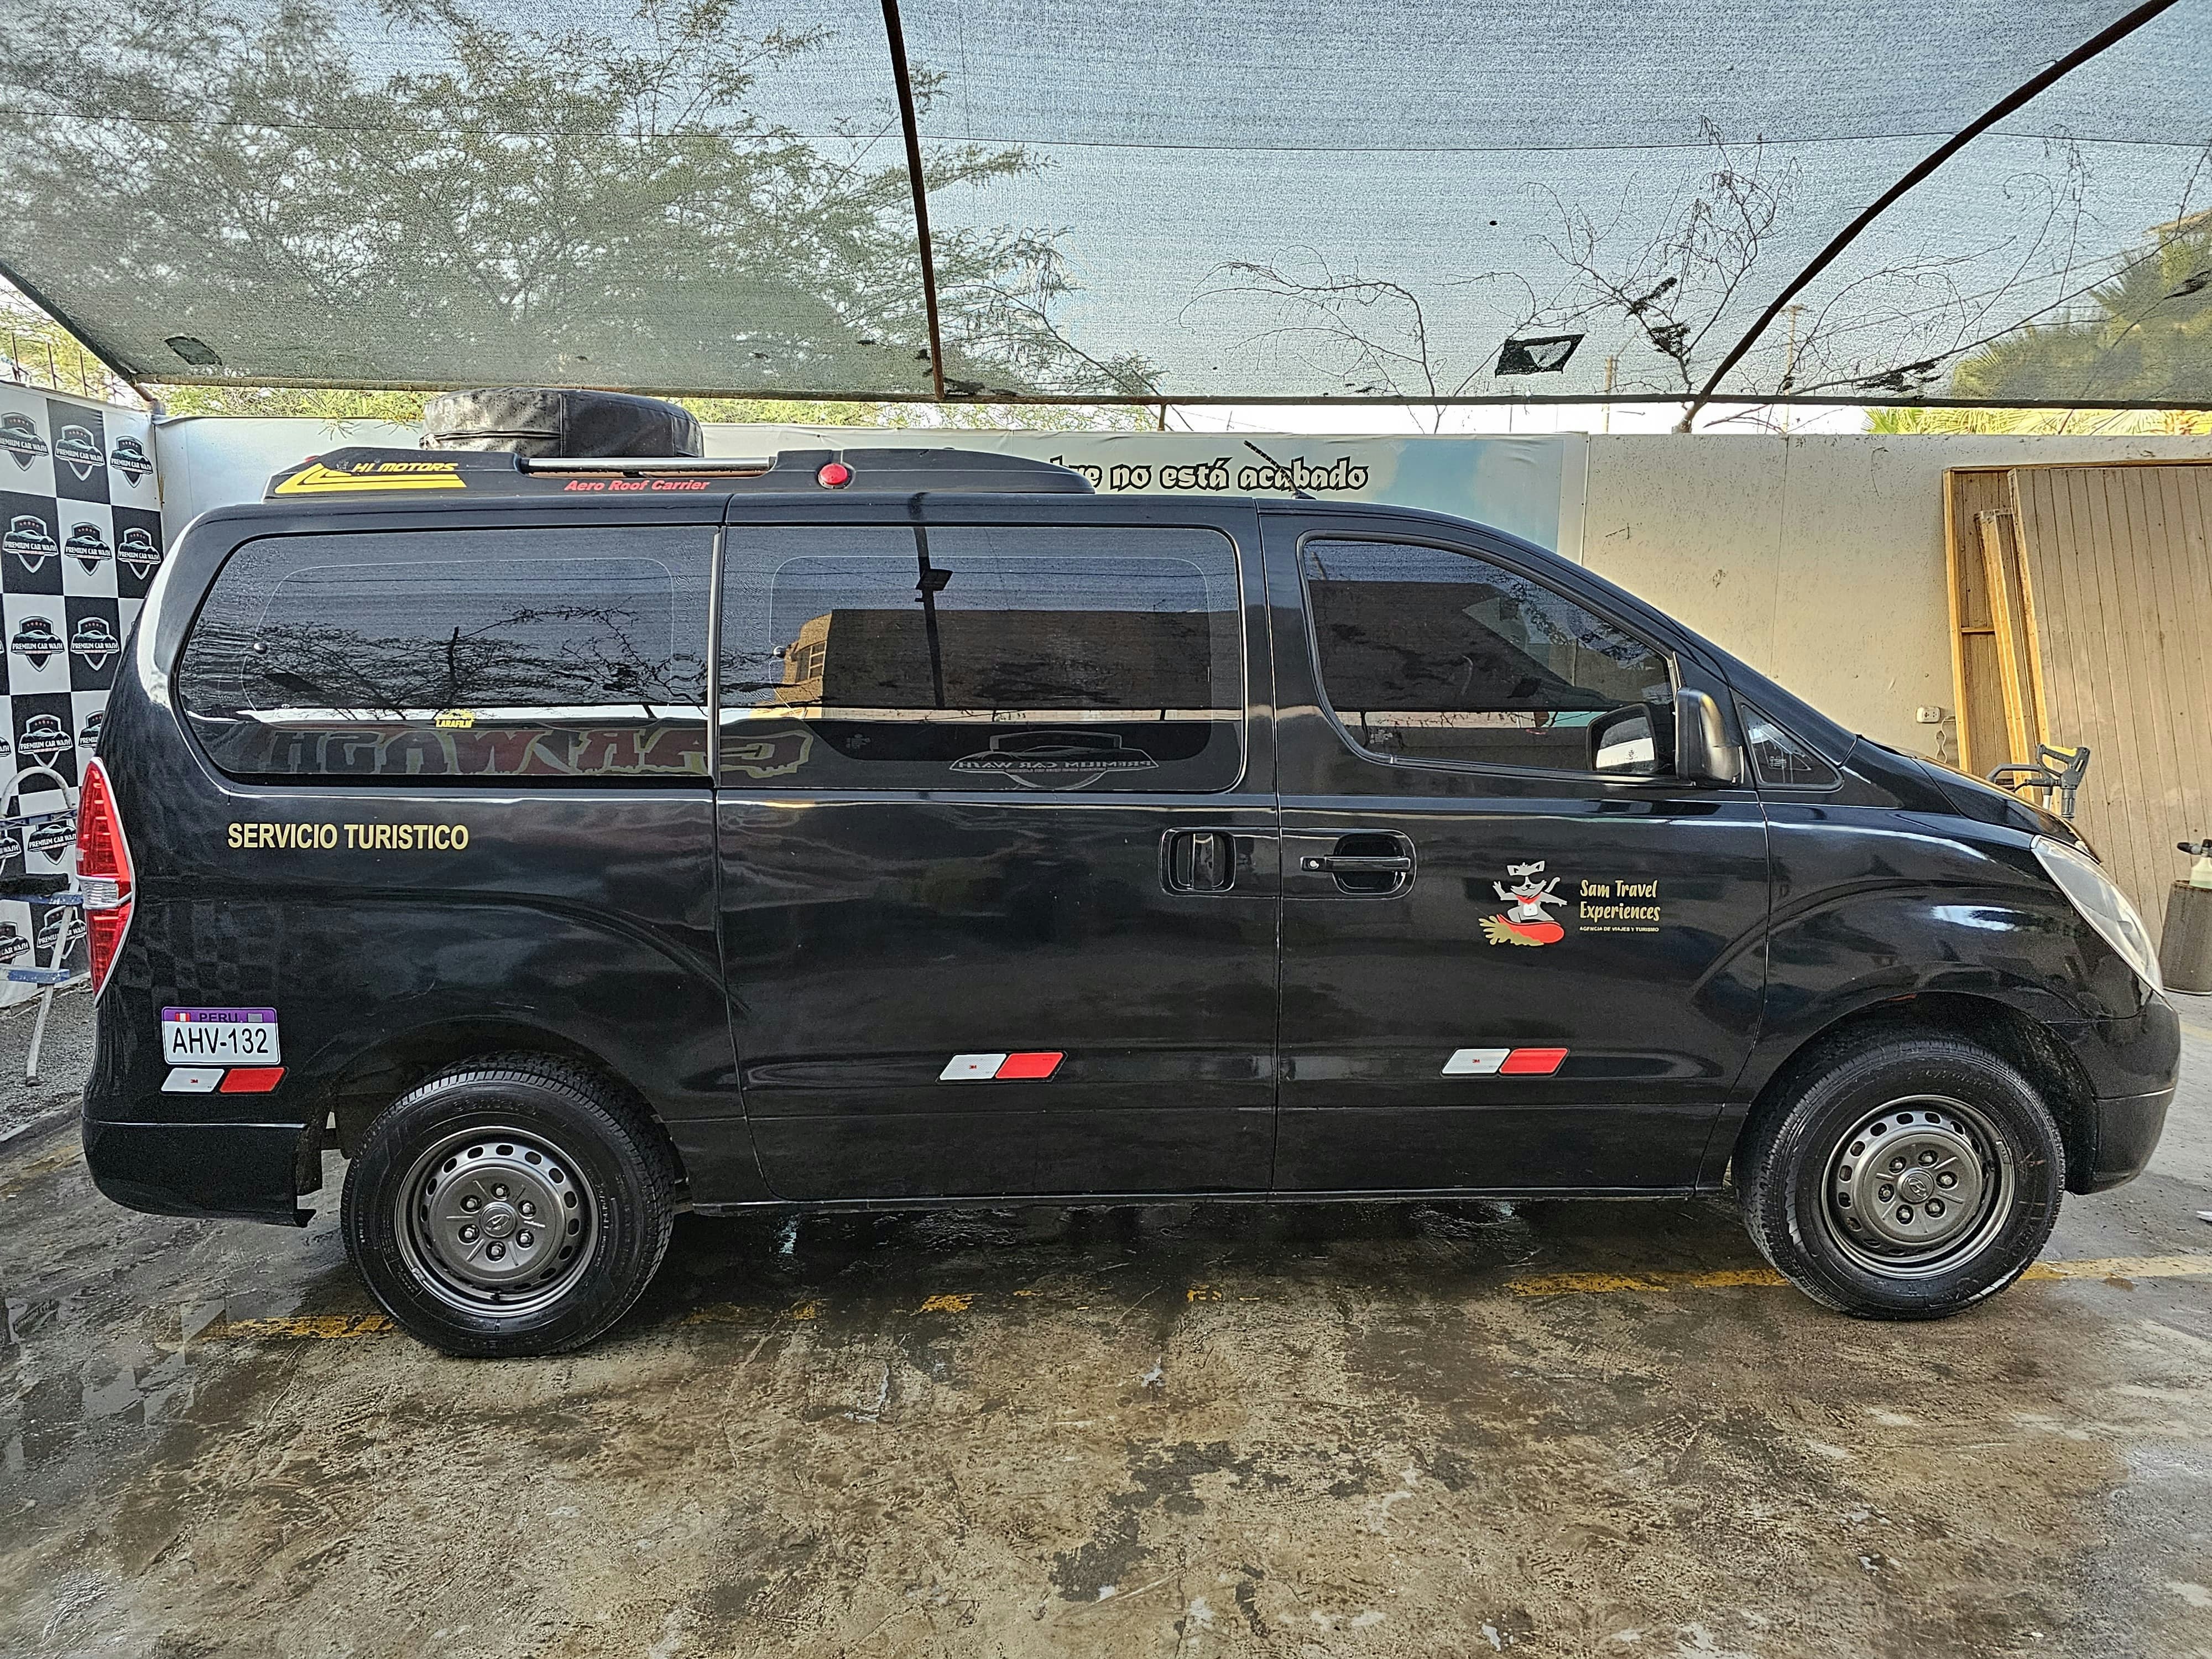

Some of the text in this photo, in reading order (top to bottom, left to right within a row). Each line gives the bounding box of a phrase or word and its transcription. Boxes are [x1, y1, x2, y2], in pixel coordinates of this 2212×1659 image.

[33, 444, 47, 452] WASH
[57, 448, 79, 457] PREMIUM
[89, 453, 103, 462] WASH
[111, 458, 131, 467] PREMIUM
[352, 463, 458, 472] HI MOTORS
[1110, 463, 1152, 492] no
[1160, 457, 1232, 491] está
[1238, 457, 1369, 492] acabado
[564, 479, 711, 491] Aero Roof Carrier
[20, 742, 44, 750] PREMIUM
[228, 823, 469, 849] SERVICIO TURISTICO
[29, 838, 53, 848] PREMIUM
[1580, 879, 1658, 898] Sam Travel
[1579, 901, 1661, 923] Experiences
[1, 941, 29, 955] CAR WASH
[199, 1013, 238, 1022] PERU
[173, 1027, 269, 1054] AHV-132
